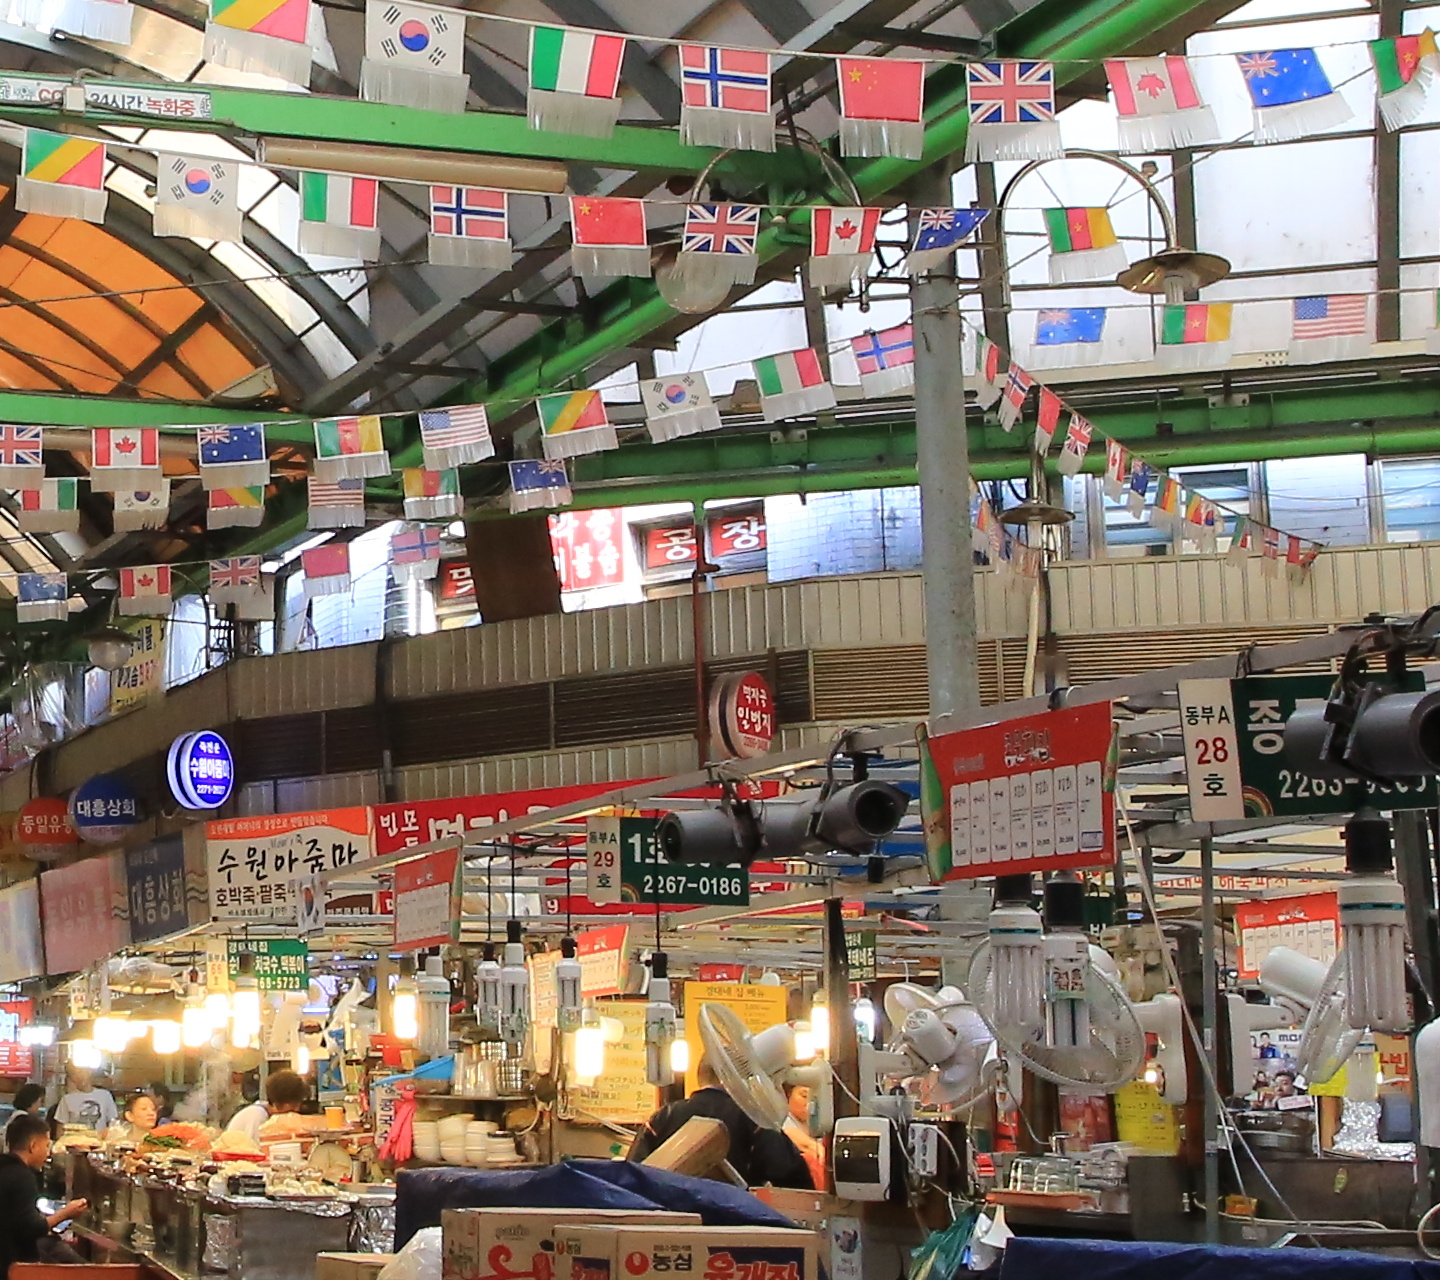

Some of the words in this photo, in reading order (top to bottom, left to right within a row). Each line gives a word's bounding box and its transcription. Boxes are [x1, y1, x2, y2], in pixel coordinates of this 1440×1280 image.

[146, 95, 196, 117] 녹화중
[737, 706, 771, 736] 일번지
[1194, 736, 1229, 766] 28
[1202, 773, 1227, 797] 호
[76, 798, 135, 817] 대흥상회
[217, 838, 359, 884] 수원아줌마
[593, 850, 615, 868] 29
[597, 873, 612, 889] 호
[643, 875, 742, 896] 2267-0186
[259, 976, 300, 989] 68-5723
[652, 1253, 693, 1272] 농심
